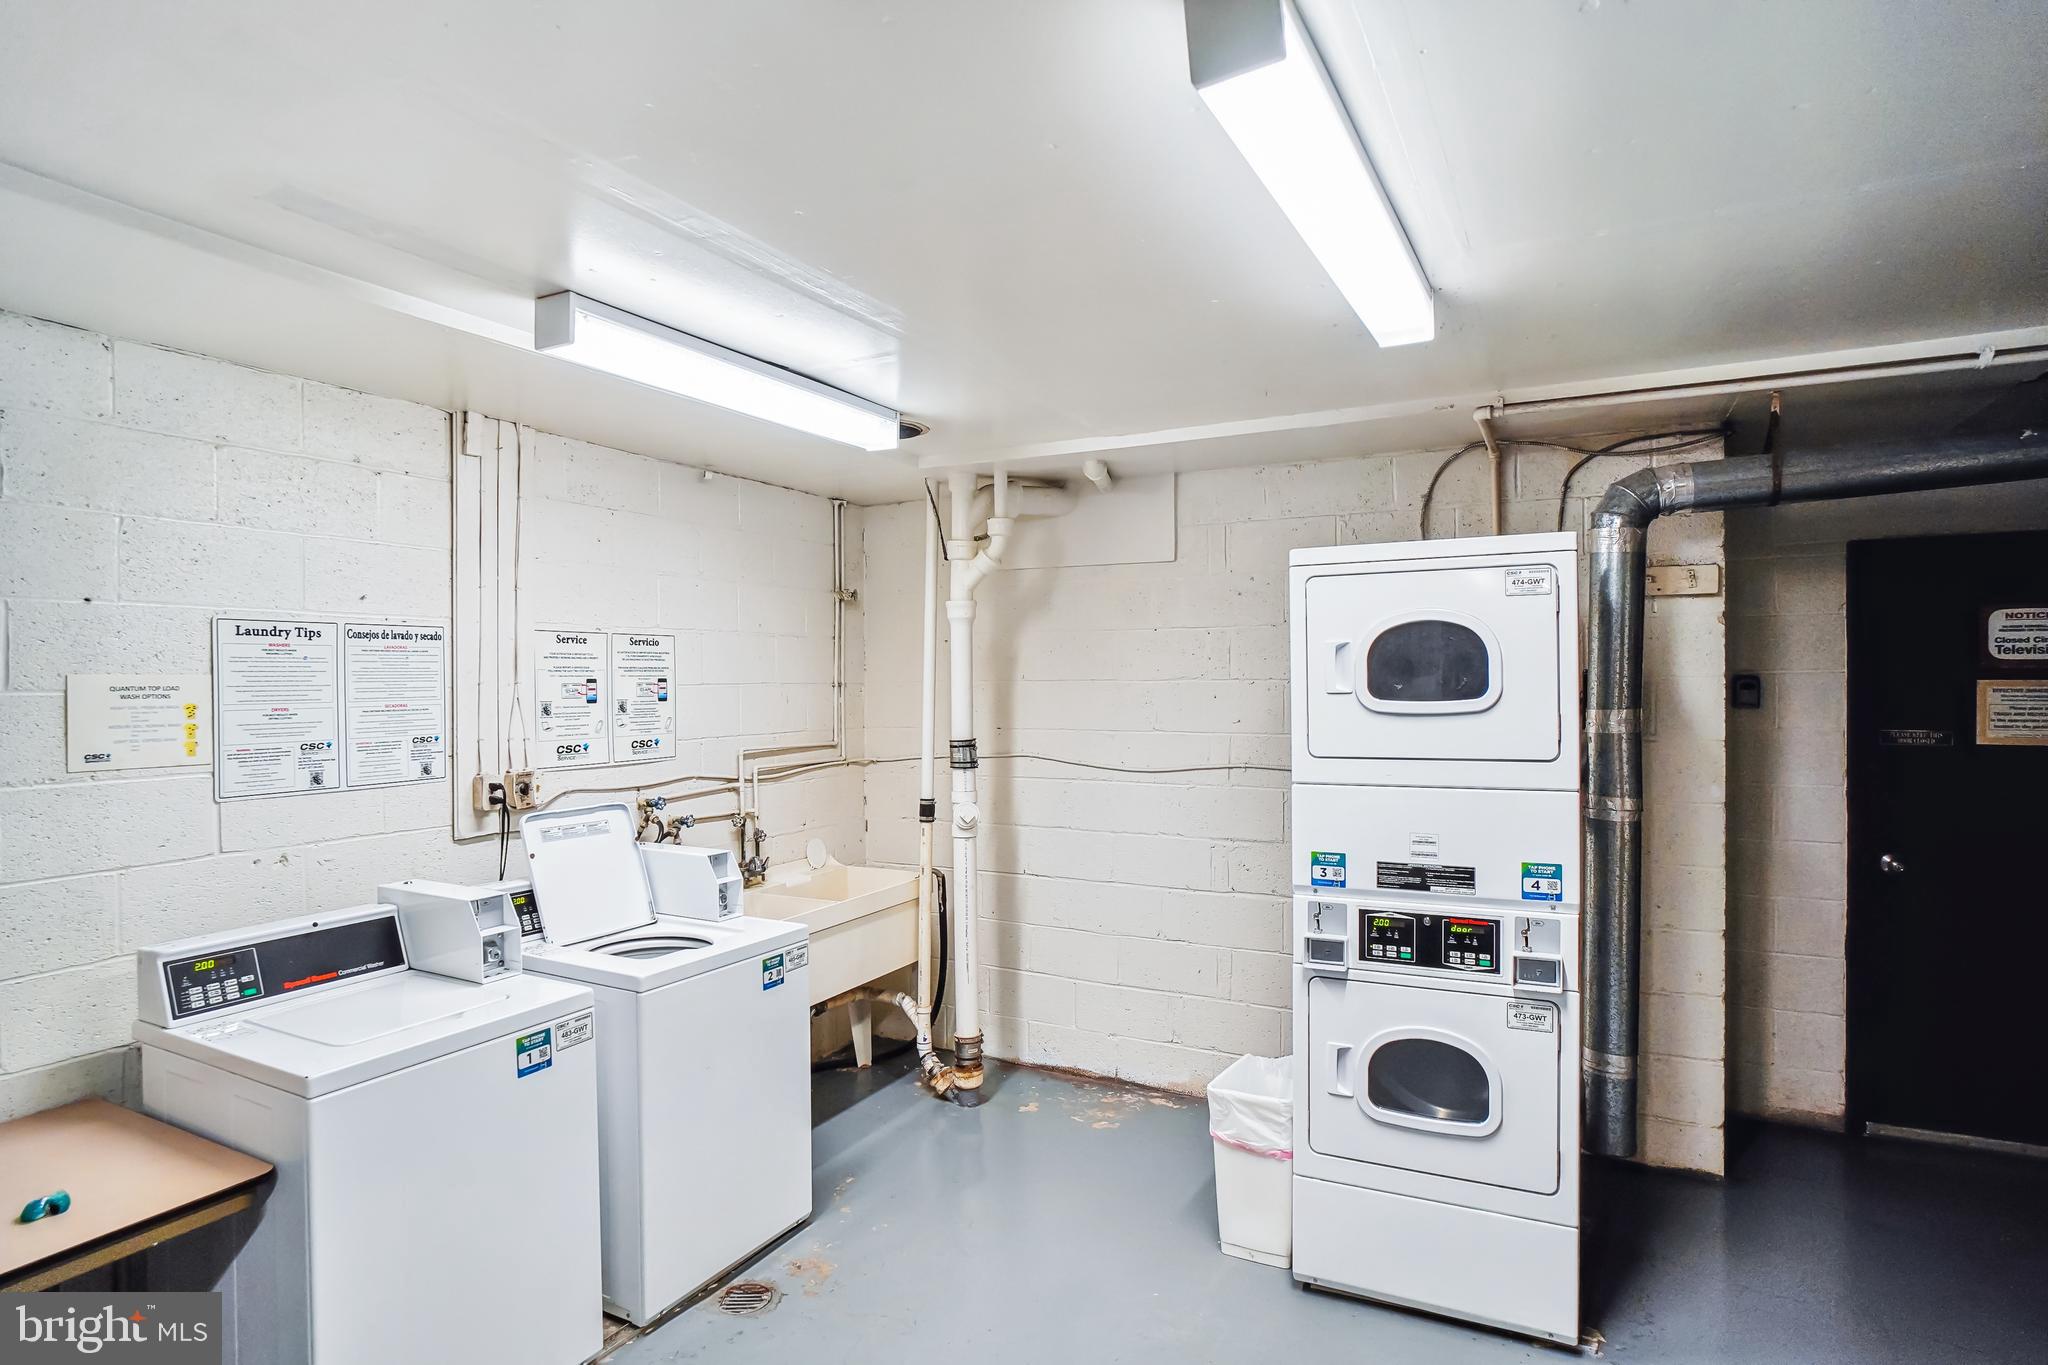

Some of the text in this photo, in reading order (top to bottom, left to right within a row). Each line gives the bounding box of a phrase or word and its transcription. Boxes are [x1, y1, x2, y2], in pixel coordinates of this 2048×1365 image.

[235, 625, 322, 640] Laundry Tips
[347, 628, 442, 643] Consejos de lavado y secado
[555, 634, 588, 644] Service
[629, 637, 660, 646] Servicio
[412, 736, 433, 744] CSC
[631, 739, 654, 749] CSC
[300, 742, 325, 751] CSC
[556, 744, 582, 754] CSC
[1319, 867, 1327, 878] 3
[1530, 880, 1541, 890] 4
[1450, 925, 1473, 933] door
[768, 971, 773, 981] 2
[1513, 1013, 1547, 1022] 473-GWT
[561, 1023, 588, 1039] 483-GWT
[526, 1053, 532, 1064] 1
